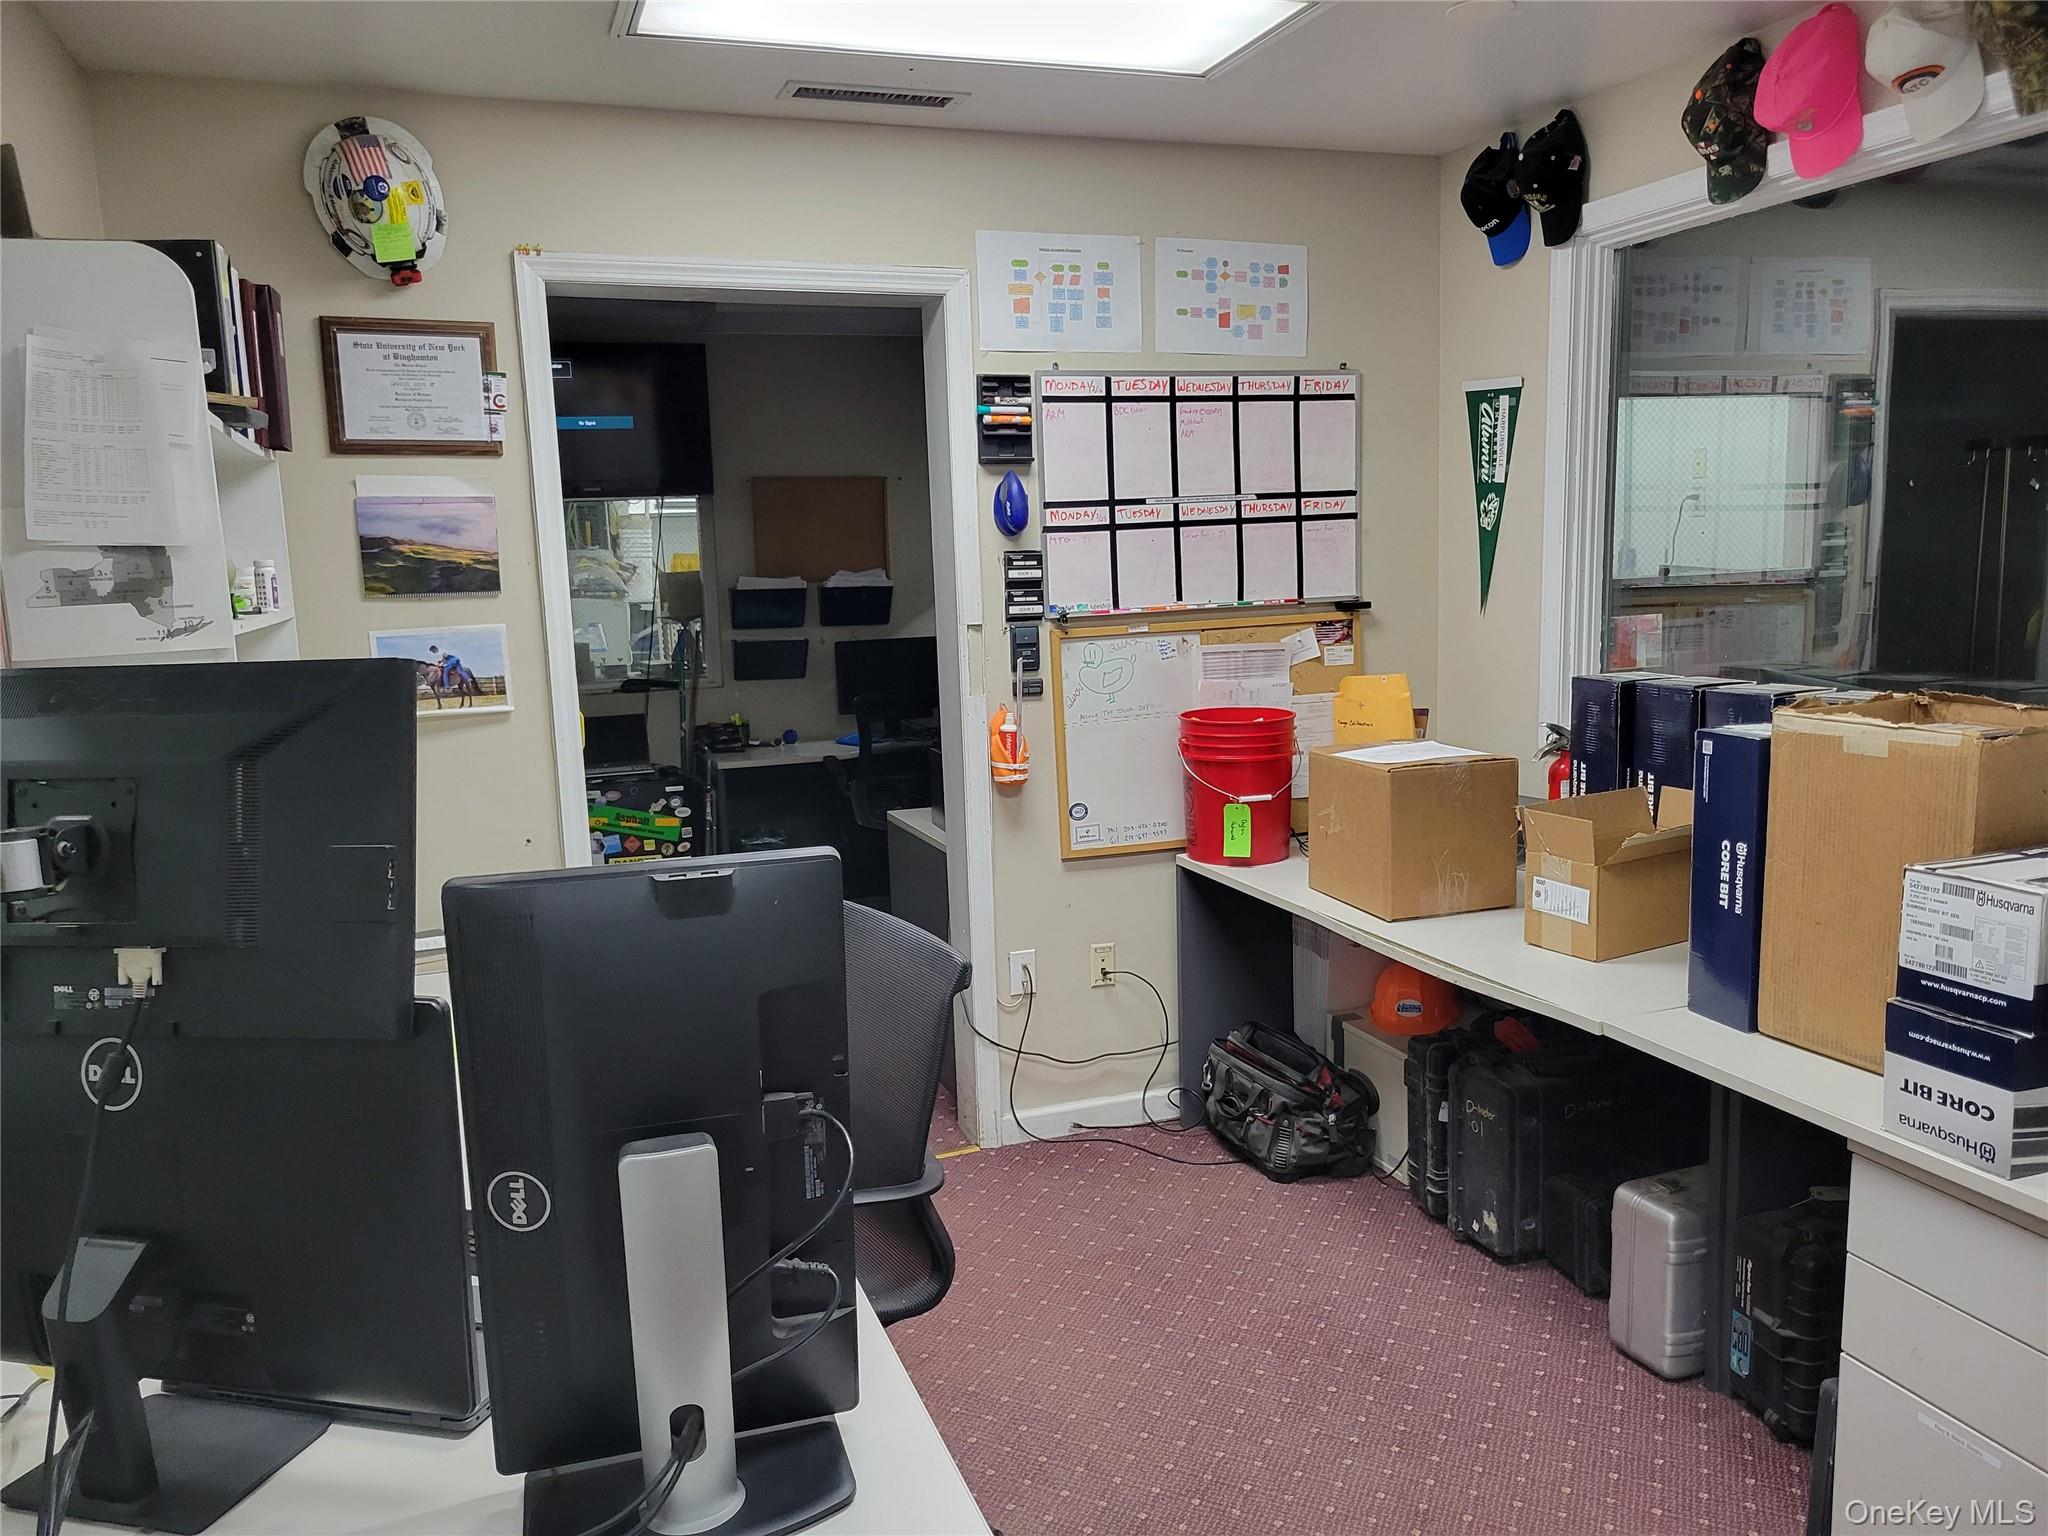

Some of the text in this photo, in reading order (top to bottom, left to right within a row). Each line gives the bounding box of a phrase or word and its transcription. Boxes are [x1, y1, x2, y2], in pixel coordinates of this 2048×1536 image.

[352, 341, 466, 353] State University of New York
[392, 353, 439, 362] Binghamton
[1045, 379, 1092, 393] MONDAY
[1113, 378, 1168, 393] TUESDAY
[1177, 379, 1232, 392] WEDNESDAY
[1240, 380, 1291, 392] THURSDAY
[1304, 378, 1349, 393] FRIDAY
[1045, 408, 1066, 421] ARM
[1481, 402, 1494, 484] Alumni
[1181, 505, 1235, 517] WEDNESDAY
[1242, 502, 1293, 514] THURSDAY
[1303, 499, 1346, 511] FRIDAY
[1050, 508, 1096, 523] MONDAY
[1117, 506, 1161, 520] TUESDAY
[1719, 839, 1731, 909] CORE BIT
[1734, 855, 1746, 915] Husqvarna
[1986, 895, 2035, 915] Husqvarna
[53, 985, 74, 993] DELL
[1920, 979, 2007, 1007] www.husqvarnacp.com
[1908, 1031, 1991, 1062] www.husqvarnacp.com
[88, 1064, 136, 1084] DL
[1900, 1078, 1995, 1122] CORE BIT
[1899, 1112, 1977, 1155] Husqvarna
[509, 1178, 528, 1225] DELL
